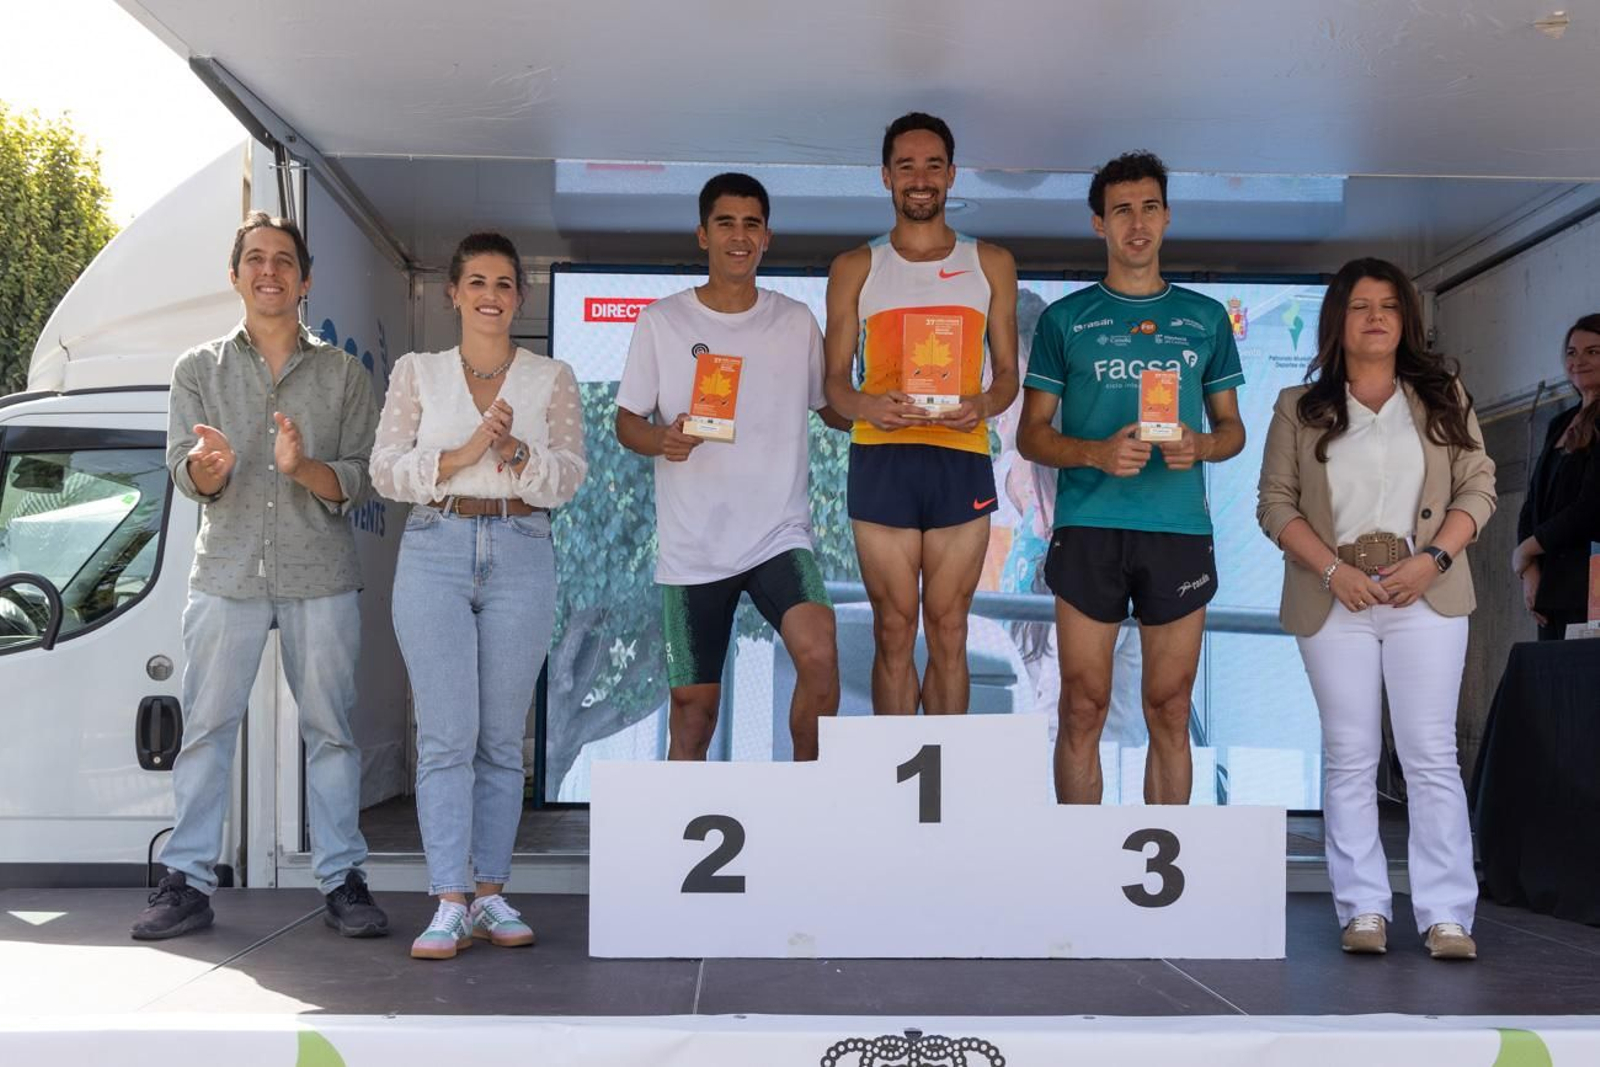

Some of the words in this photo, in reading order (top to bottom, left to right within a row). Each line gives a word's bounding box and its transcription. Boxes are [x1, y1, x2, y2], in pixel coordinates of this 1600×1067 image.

[591, 303, 648, 318] DIRECT
[897, 745, 941, 823] 1
[681, 815, 745, 893] 2
[1122, 829, 1184, 907] 3
